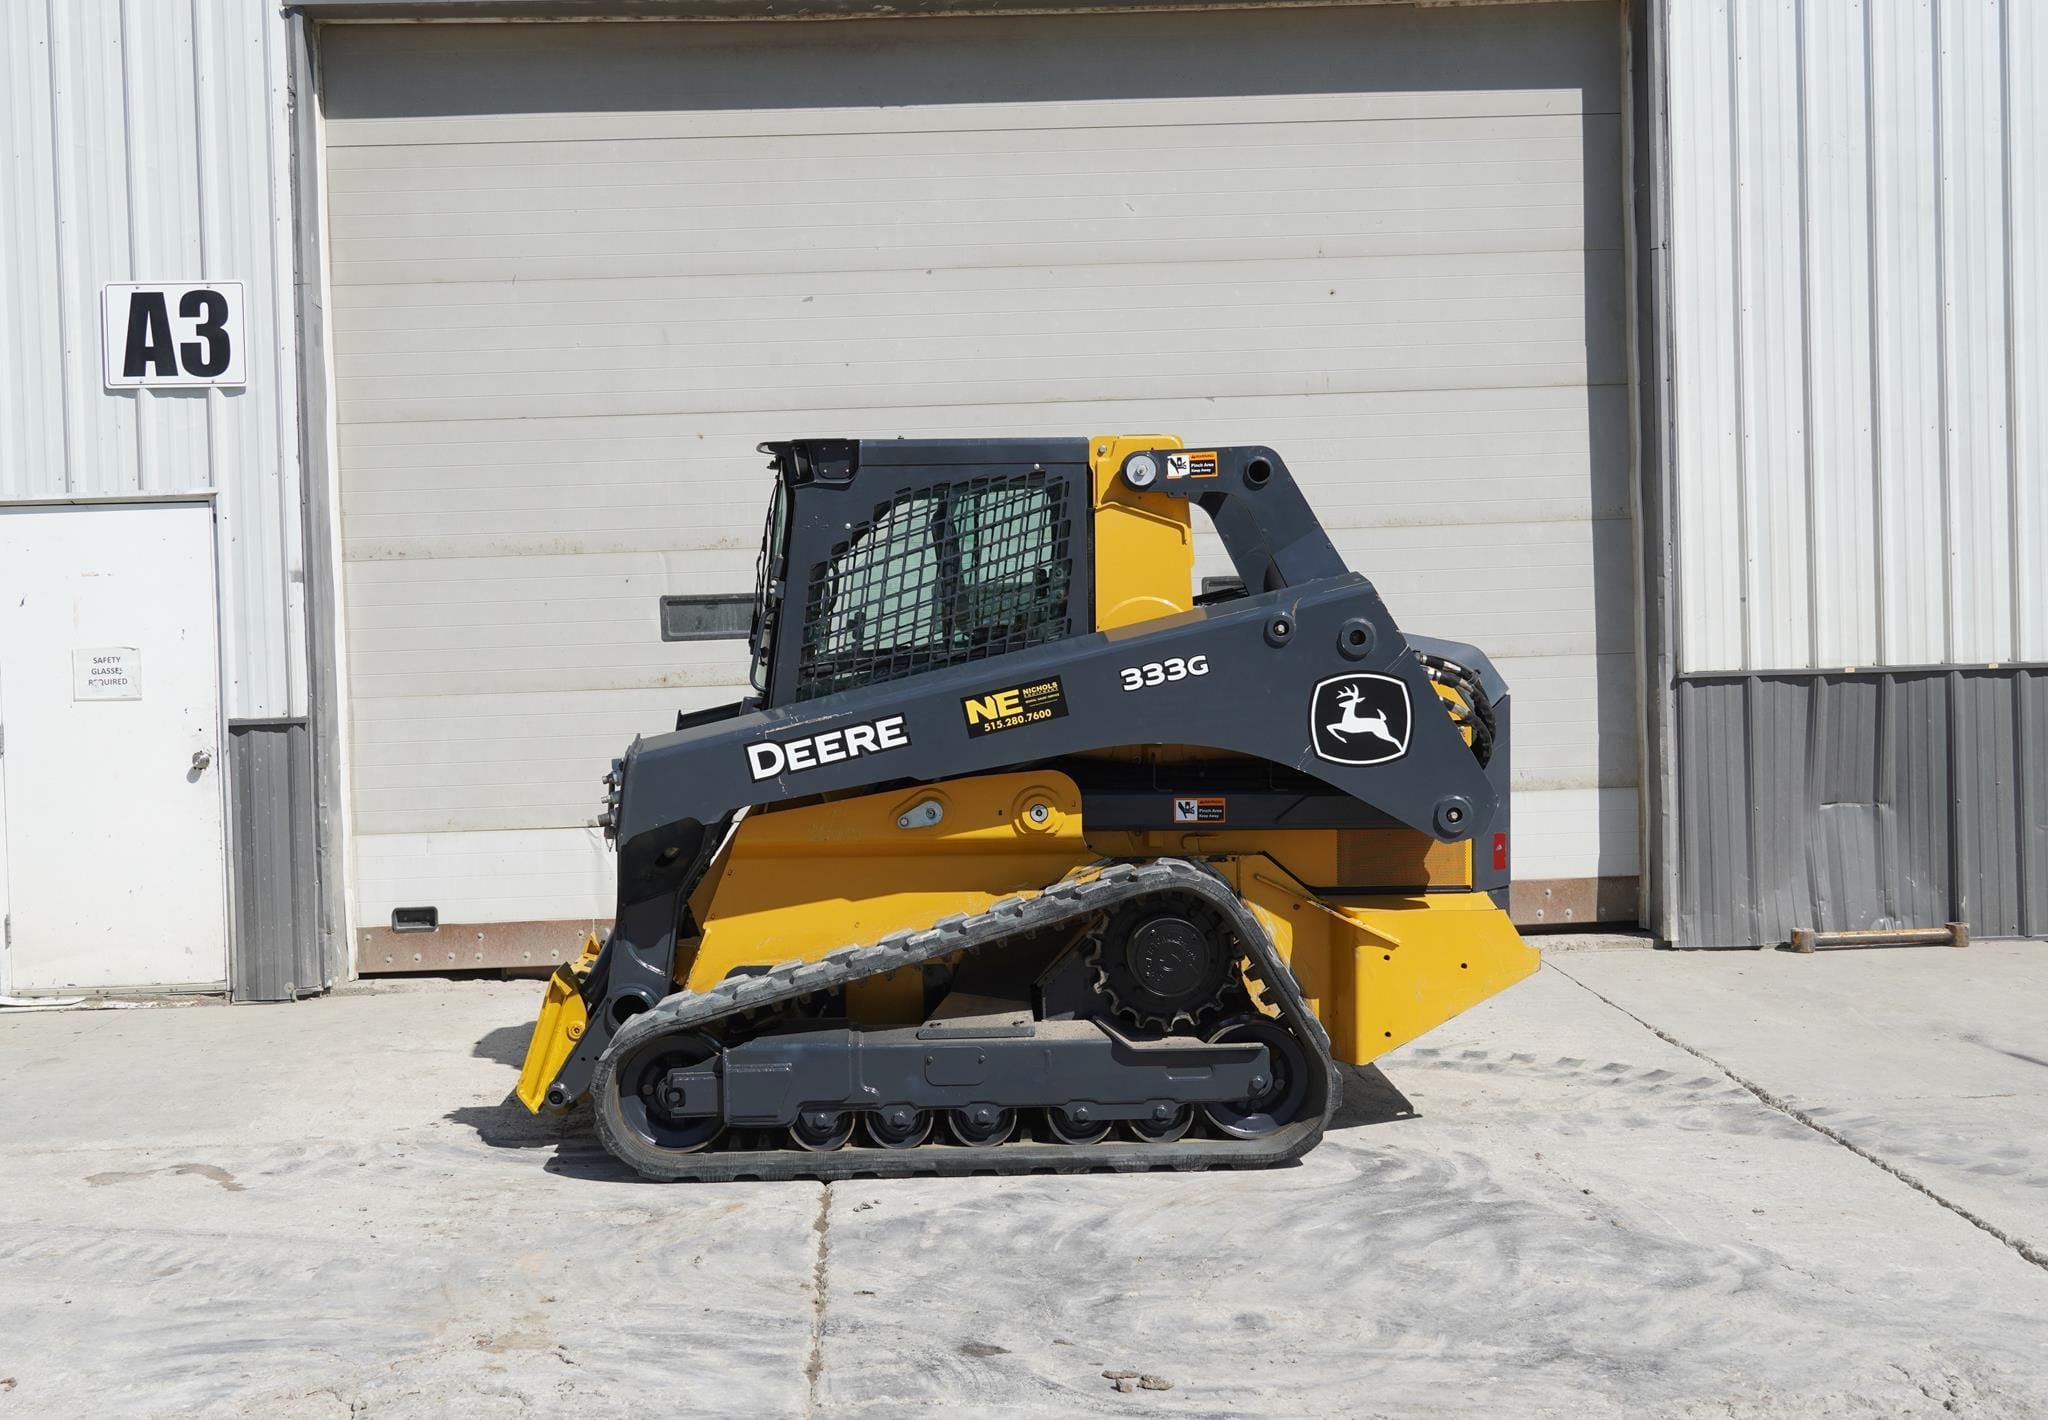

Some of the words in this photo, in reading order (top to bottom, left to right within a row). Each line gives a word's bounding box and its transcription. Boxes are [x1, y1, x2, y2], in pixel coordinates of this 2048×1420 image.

[123, 289, 231, 378] A3
[92, 656, 121, 664] SAFETY
[1120, 655, 1209, 691] 333G
[1022, 681, 1058, 695] NICHOLS
[965, 689, 1024, 725] NE
[984, 708, 1052, 732] 515.280.7600
[747, 716, 908, 780] DEERE
